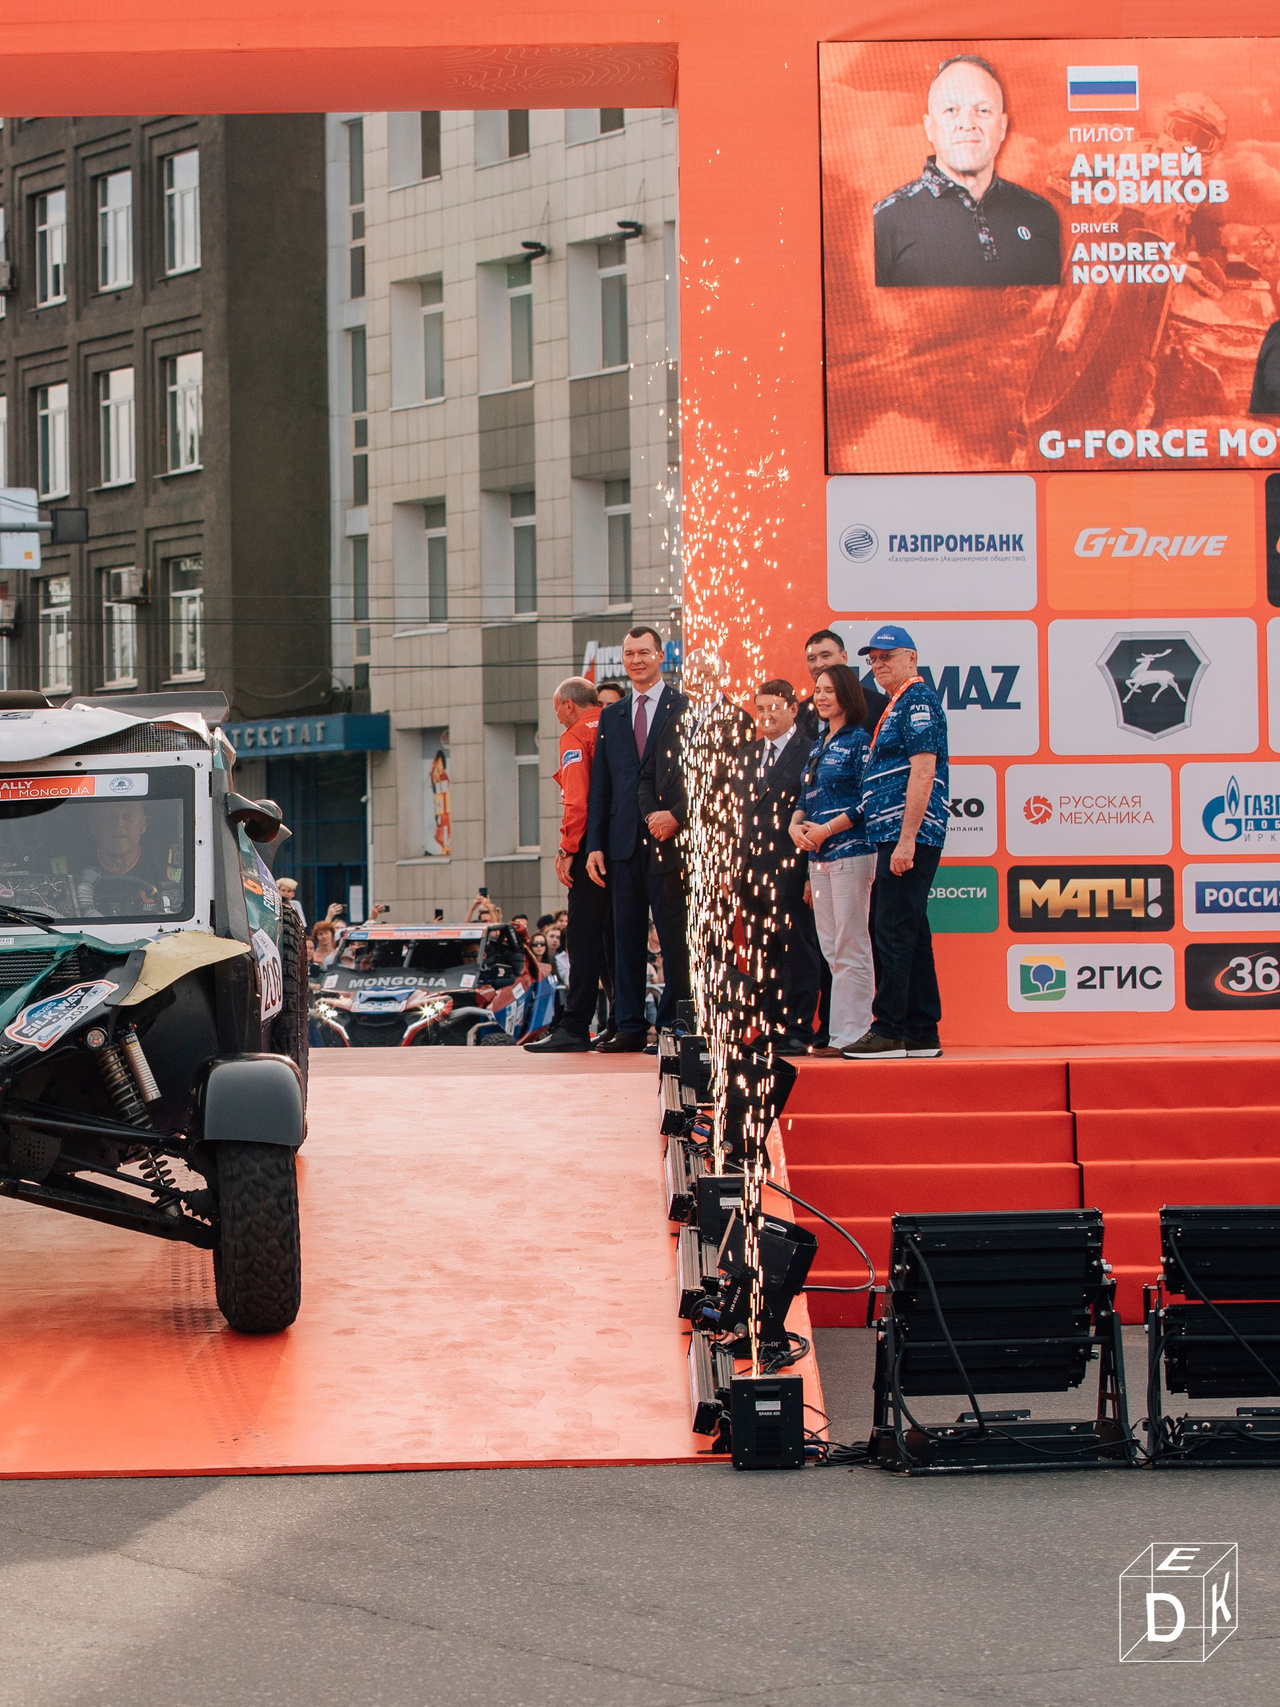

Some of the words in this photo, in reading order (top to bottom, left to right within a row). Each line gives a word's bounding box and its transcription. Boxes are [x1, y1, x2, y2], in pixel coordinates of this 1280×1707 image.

[1069, 127, 1134, 143] ПИЛОТ
[1070, 146, 1203, 181] АНДРЕЙ
[1070, 179, 1229, 205] НОВИКОВ
[1070, 222, 1119, 234] DRIVER
[1071, 242, 1176, 262] ANDREY
[1072, 264, 1187, 285] NOVIKOV
[1038, 428, 1208, 460] G-FORCE
[1219, 428, 1280, 457] MO
[888, 533, 1024, 553] ГАЗПРОМБАНК
[849, 665, 1021, 710] KMAZ
[18, 786, 90, 798] MONGOLIA
[1059, 794, 1142, 809] РУССКАЯ
[1059, 810, 1155, 825] МЕХАНИКА
[928, 887, 987, 899] ОВОСТИ
[1019, 877, 1163, 919] МАТЧ!
[1204, 887, 1280, 907] РОССИ
[348, 976, 447, 989] MONGOLIA
[1076, 965, 1163, 990] 2ГИС
[21, 1010, 60, 1036] SILK
[55, 989, 85, 1011] WAY
[65, 1005, 89, 1021] 208
